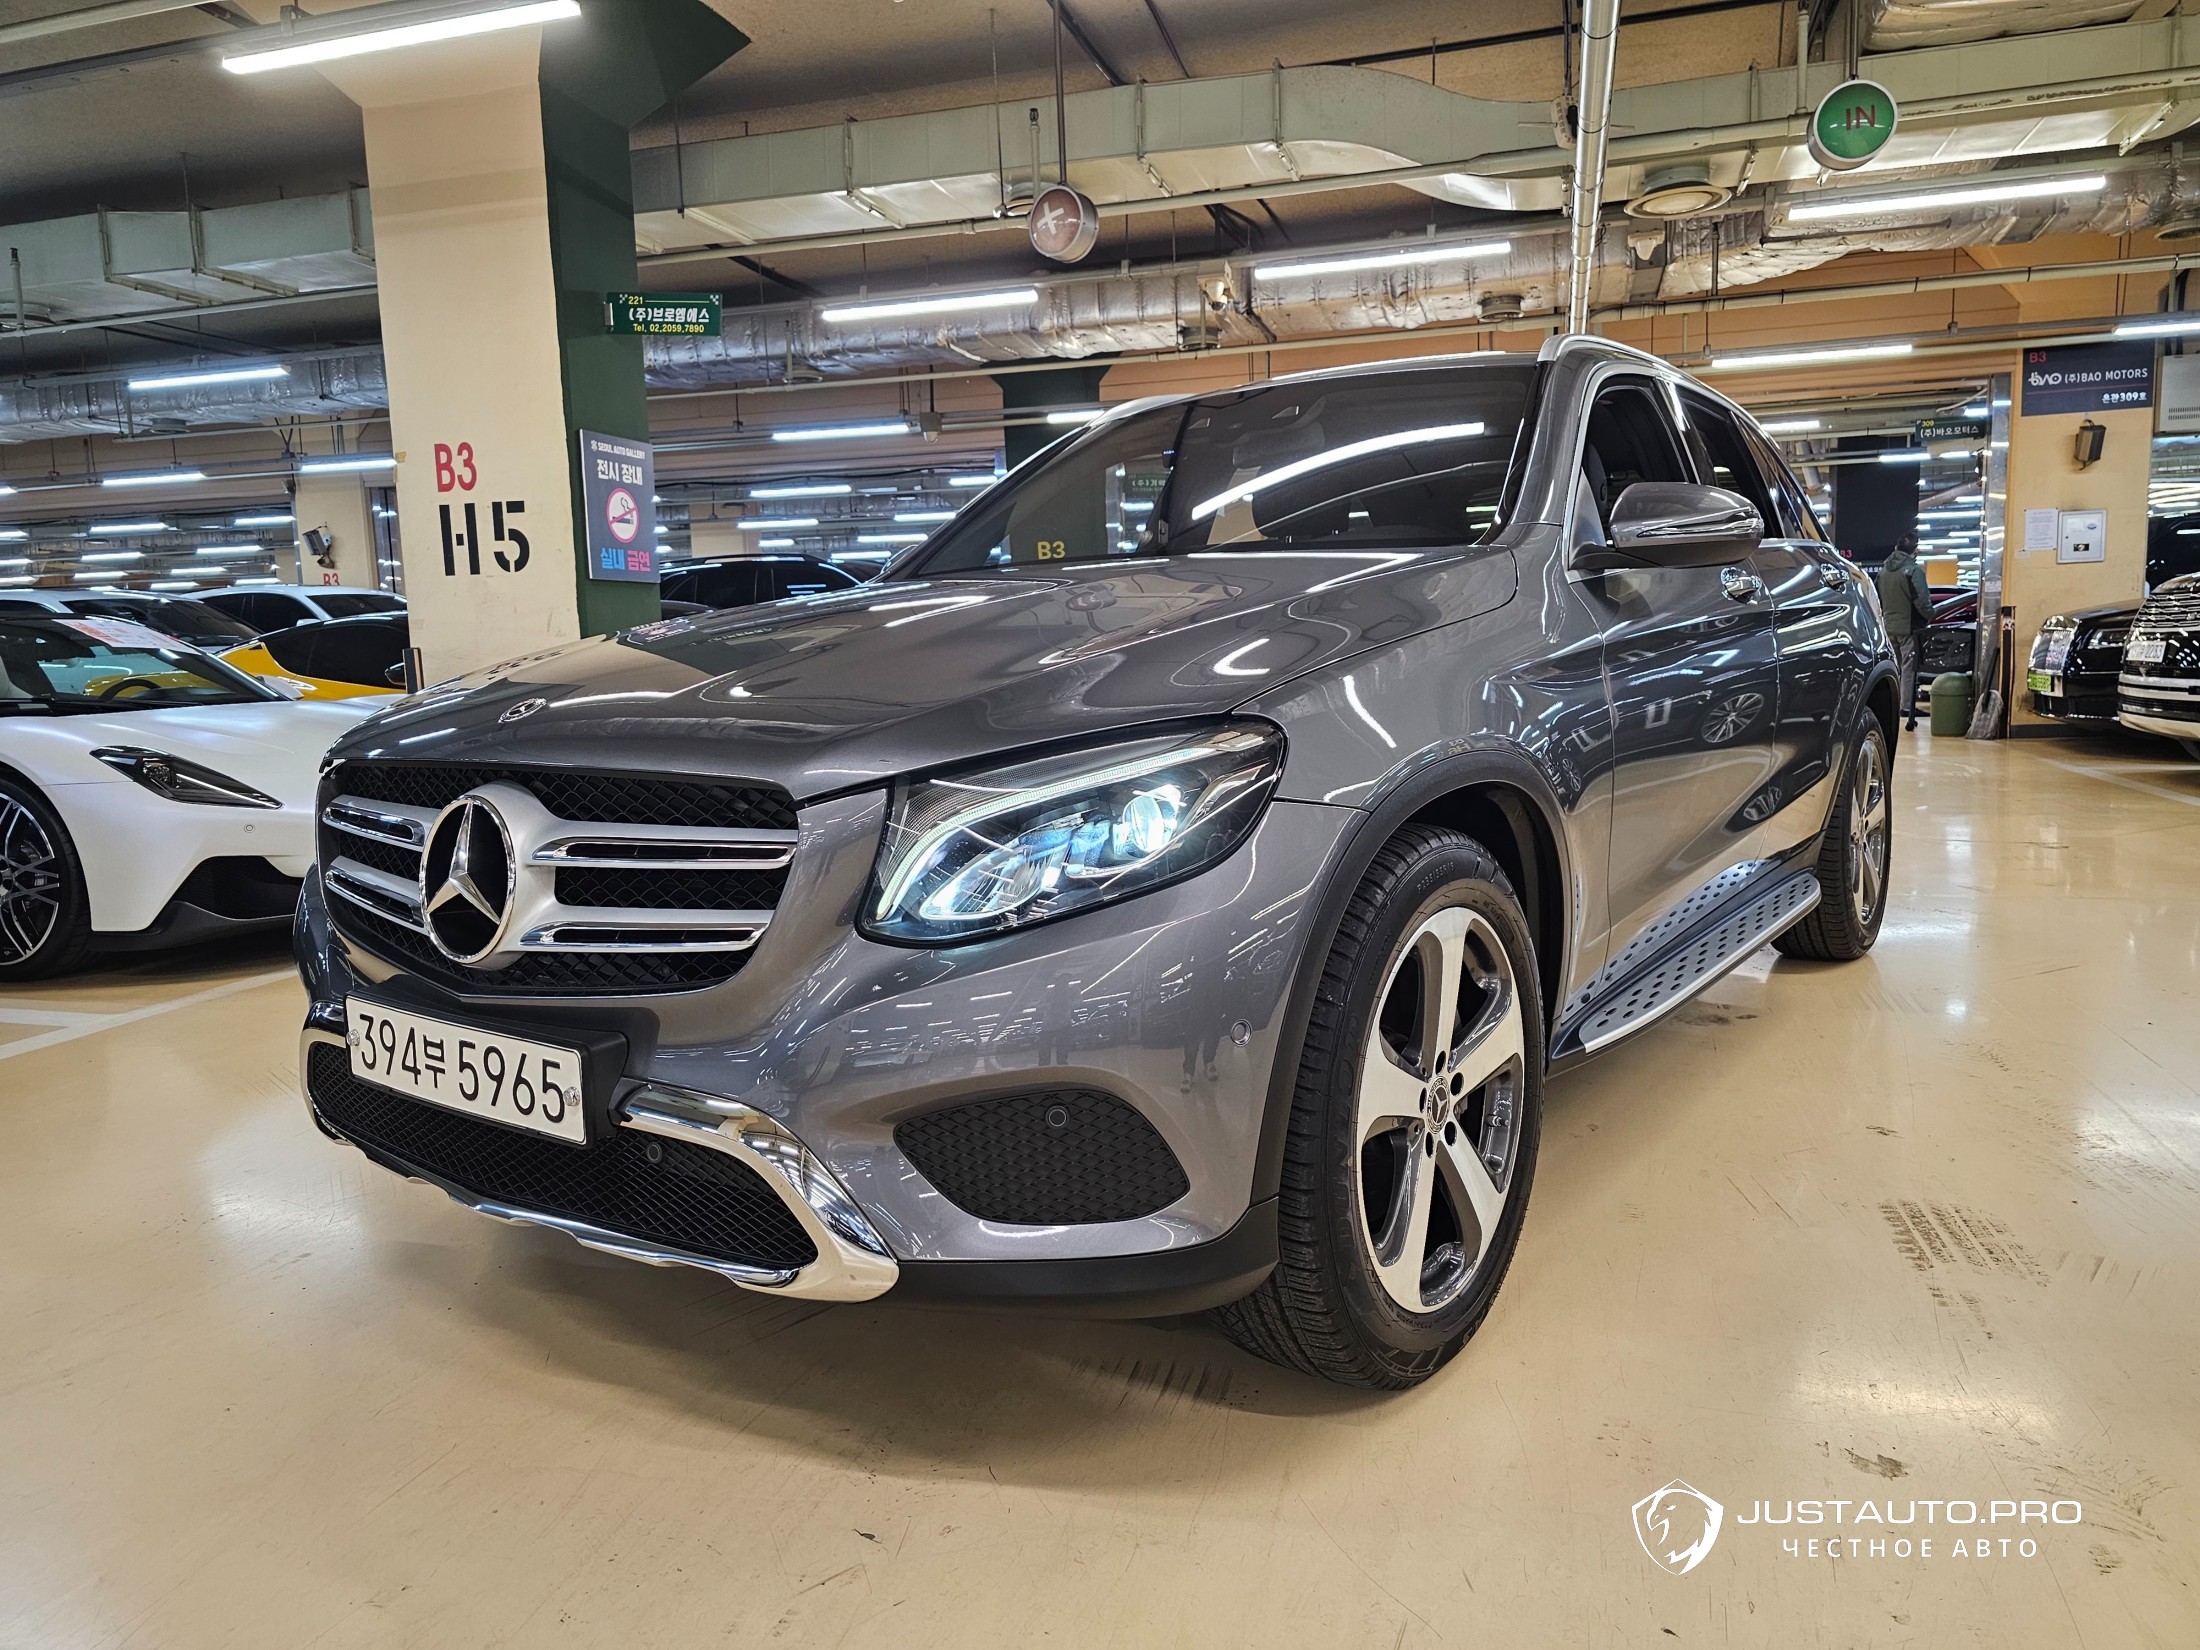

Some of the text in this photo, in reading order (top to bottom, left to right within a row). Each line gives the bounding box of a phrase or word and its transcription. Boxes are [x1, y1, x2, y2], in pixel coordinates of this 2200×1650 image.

[1845, 104, 1875, 131] IN
[628, 296, 643, 305] 221
[628, 307, 710, 323] (주)브로엠에스
[633, 323, 705, 334] Tel. 02.2059.7890
[2029, 351, 2047, 363] B3
[2105, 367, 2148, 382] MOTORS
[1920, 425, 1979, 438] (주)바오모터스
[1921, 420, 1935, 428] 309
[598, 441, 646, 460] SEOUL AUTO GALLERY
[434, 441, 478, 493] B3
[596, 459, 643, 486] 전시 장내
[438, 500, 531, 577] H5
[1037, 540, 1066, 560] B3
[600, 547, 651, 572] 실내 금연
[323, 573, 340, 586] B3
